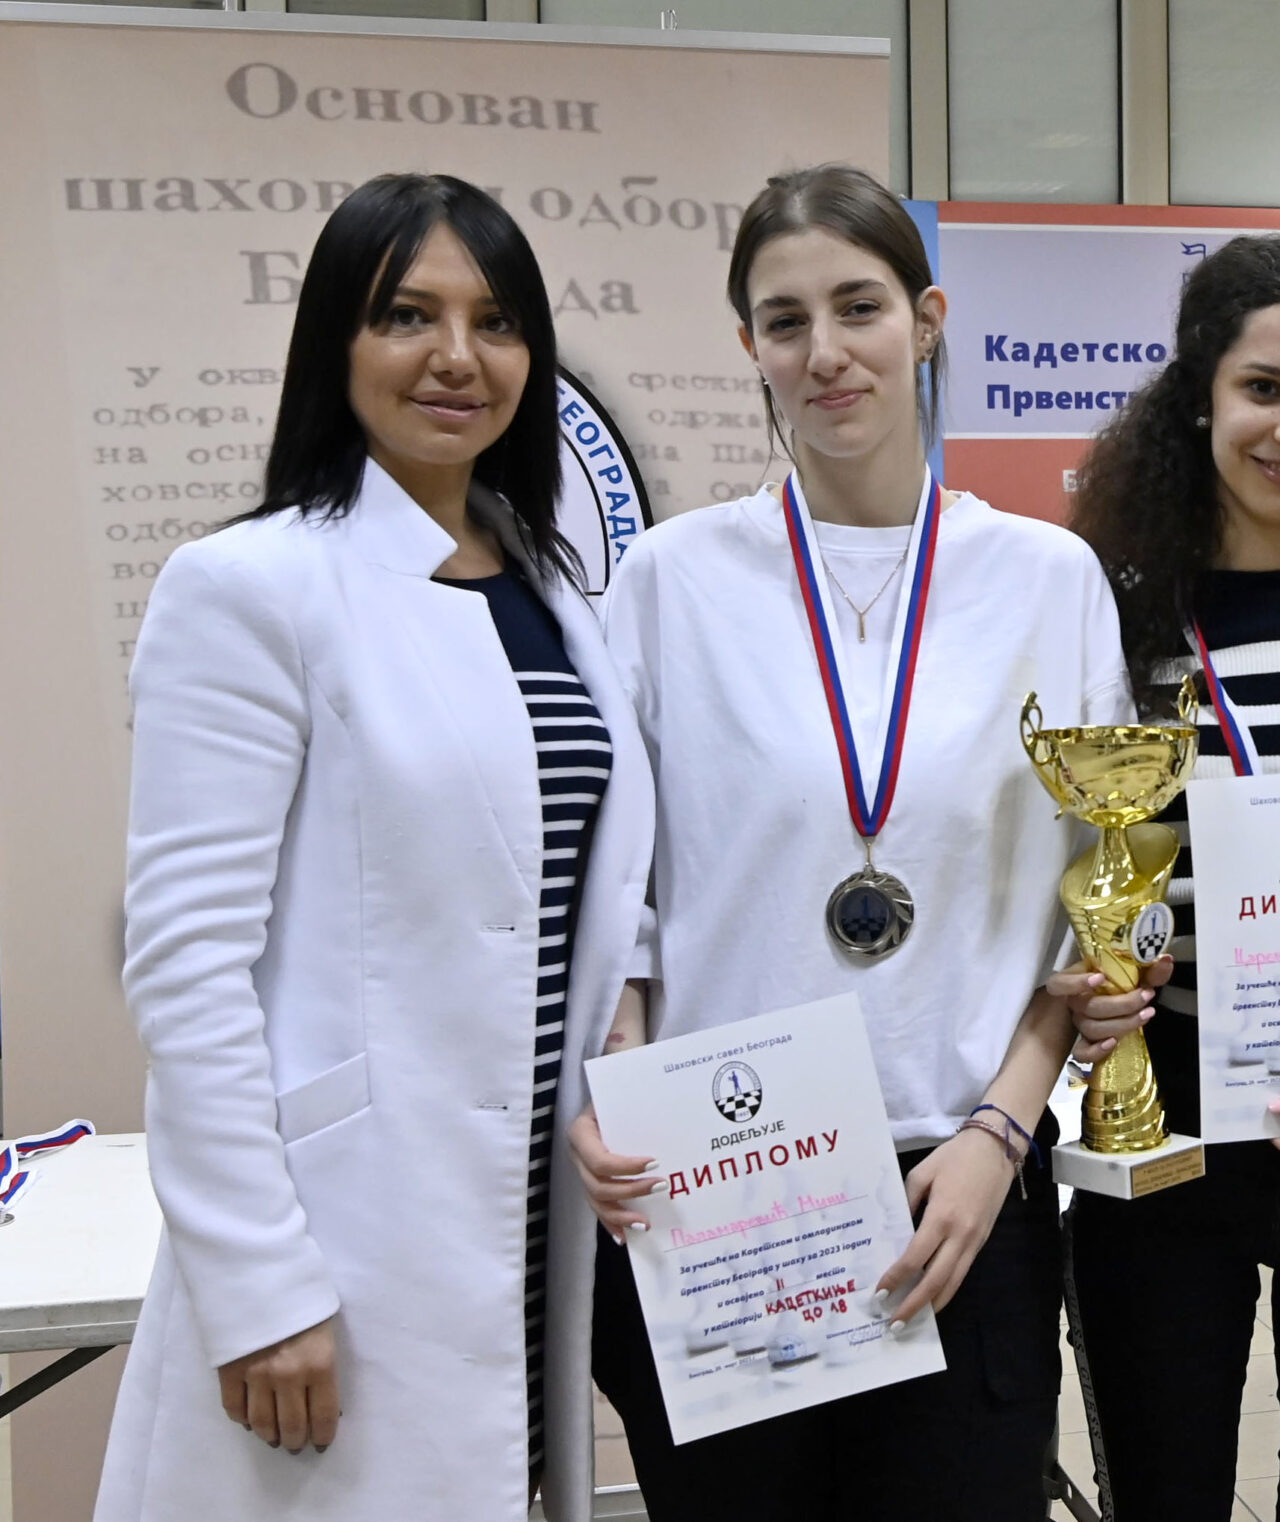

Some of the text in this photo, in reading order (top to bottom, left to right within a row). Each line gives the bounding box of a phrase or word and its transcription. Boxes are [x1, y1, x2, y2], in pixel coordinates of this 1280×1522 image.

[224, 62, 602, 134] Основан
[64, 177, 503, 212] шахов
[985, 335, 1167, 368] Кадетско
[93, 403, 264, 428] одбора,
[987, 384, 1135, 417] Првенст
[94, 446, 148, 465] на
[557, 385, 637, 565] ЕОГРАД
[103, 481, 261, 503] ховско
[106, 519, 212, 543] одбо
[664, 1034, 793, 1074] Шаховски савез Београда
[711, 1120, 786, 1151] ДОДЕЉУЈЕ
[669, 1129, 839, 1200] ДИПЛОМУ
[819, 1245, 841, 1258] 2023
[830, 1299, 848, 1313] 18
